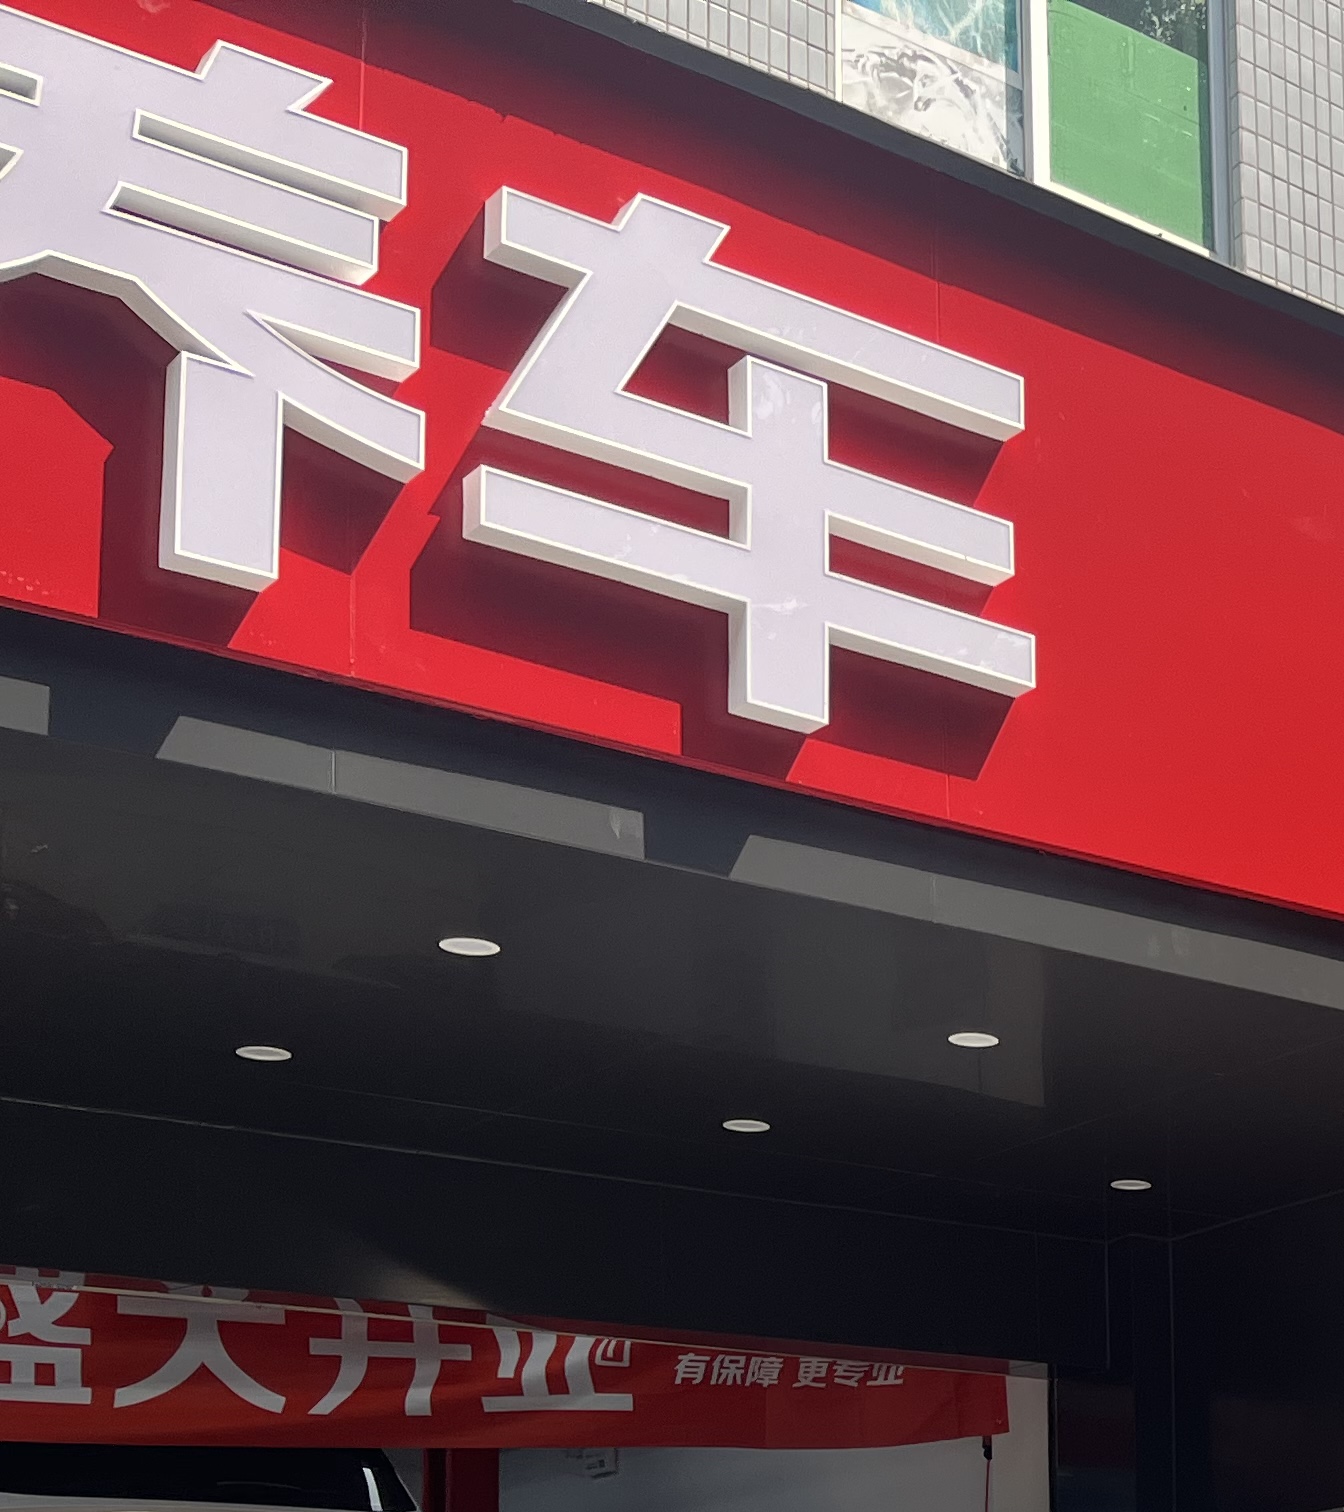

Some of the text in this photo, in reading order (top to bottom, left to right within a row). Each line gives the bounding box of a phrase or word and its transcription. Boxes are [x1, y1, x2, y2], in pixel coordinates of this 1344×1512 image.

[673, 1352, 905, 1389] 有保障 更专业
